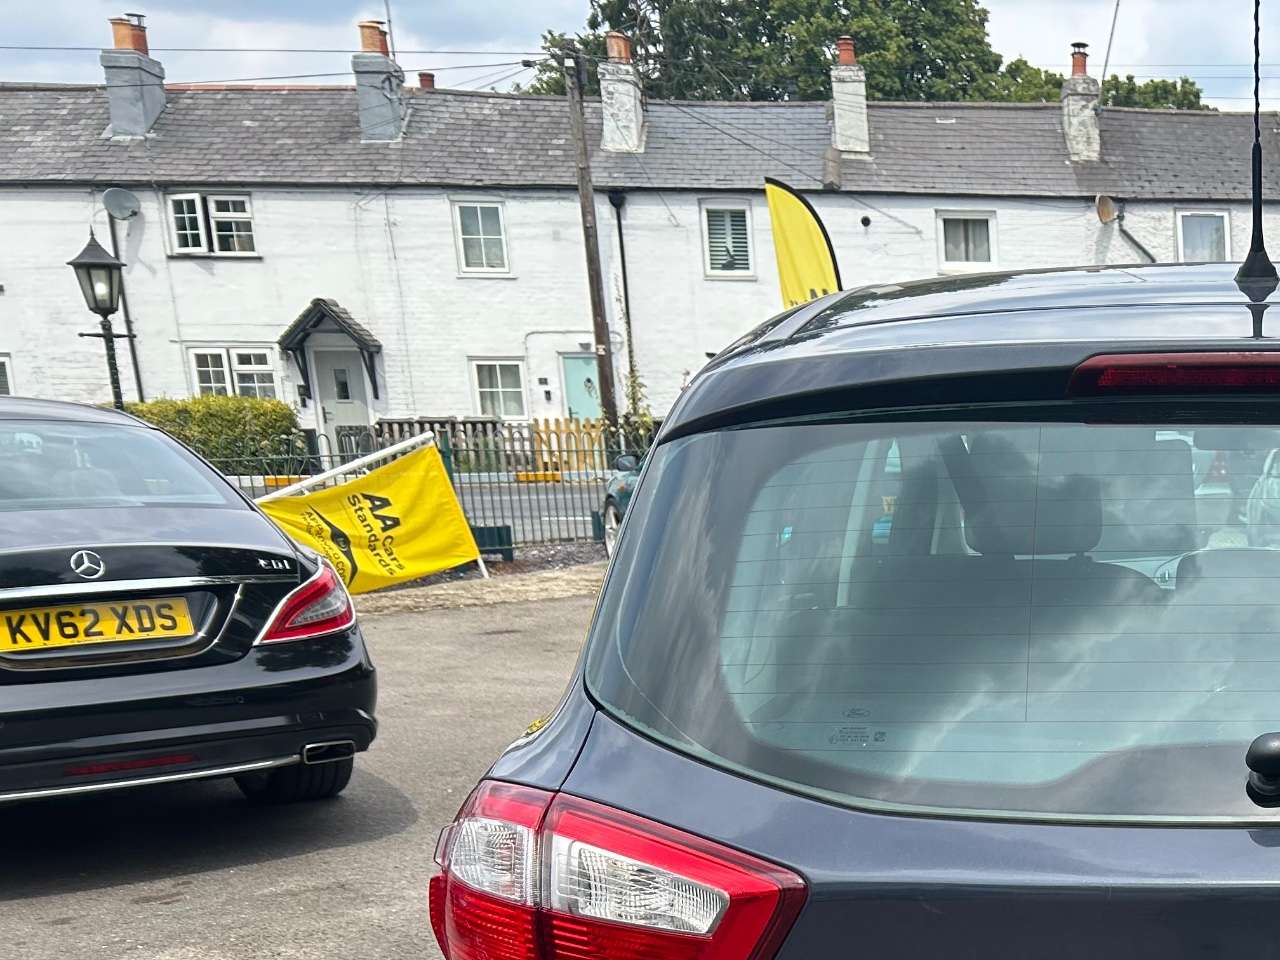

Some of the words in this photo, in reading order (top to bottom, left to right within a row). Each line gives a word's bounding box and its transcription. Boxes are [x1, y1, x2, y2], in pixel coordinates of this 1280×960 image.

[347, 494, 397, 576] Standards
[360, 492, 401, 533] AA
[382, 535, 405, 571] Cars
[5, 607, 104, 645] KV62
[110, 602, 178, 635] XDS
